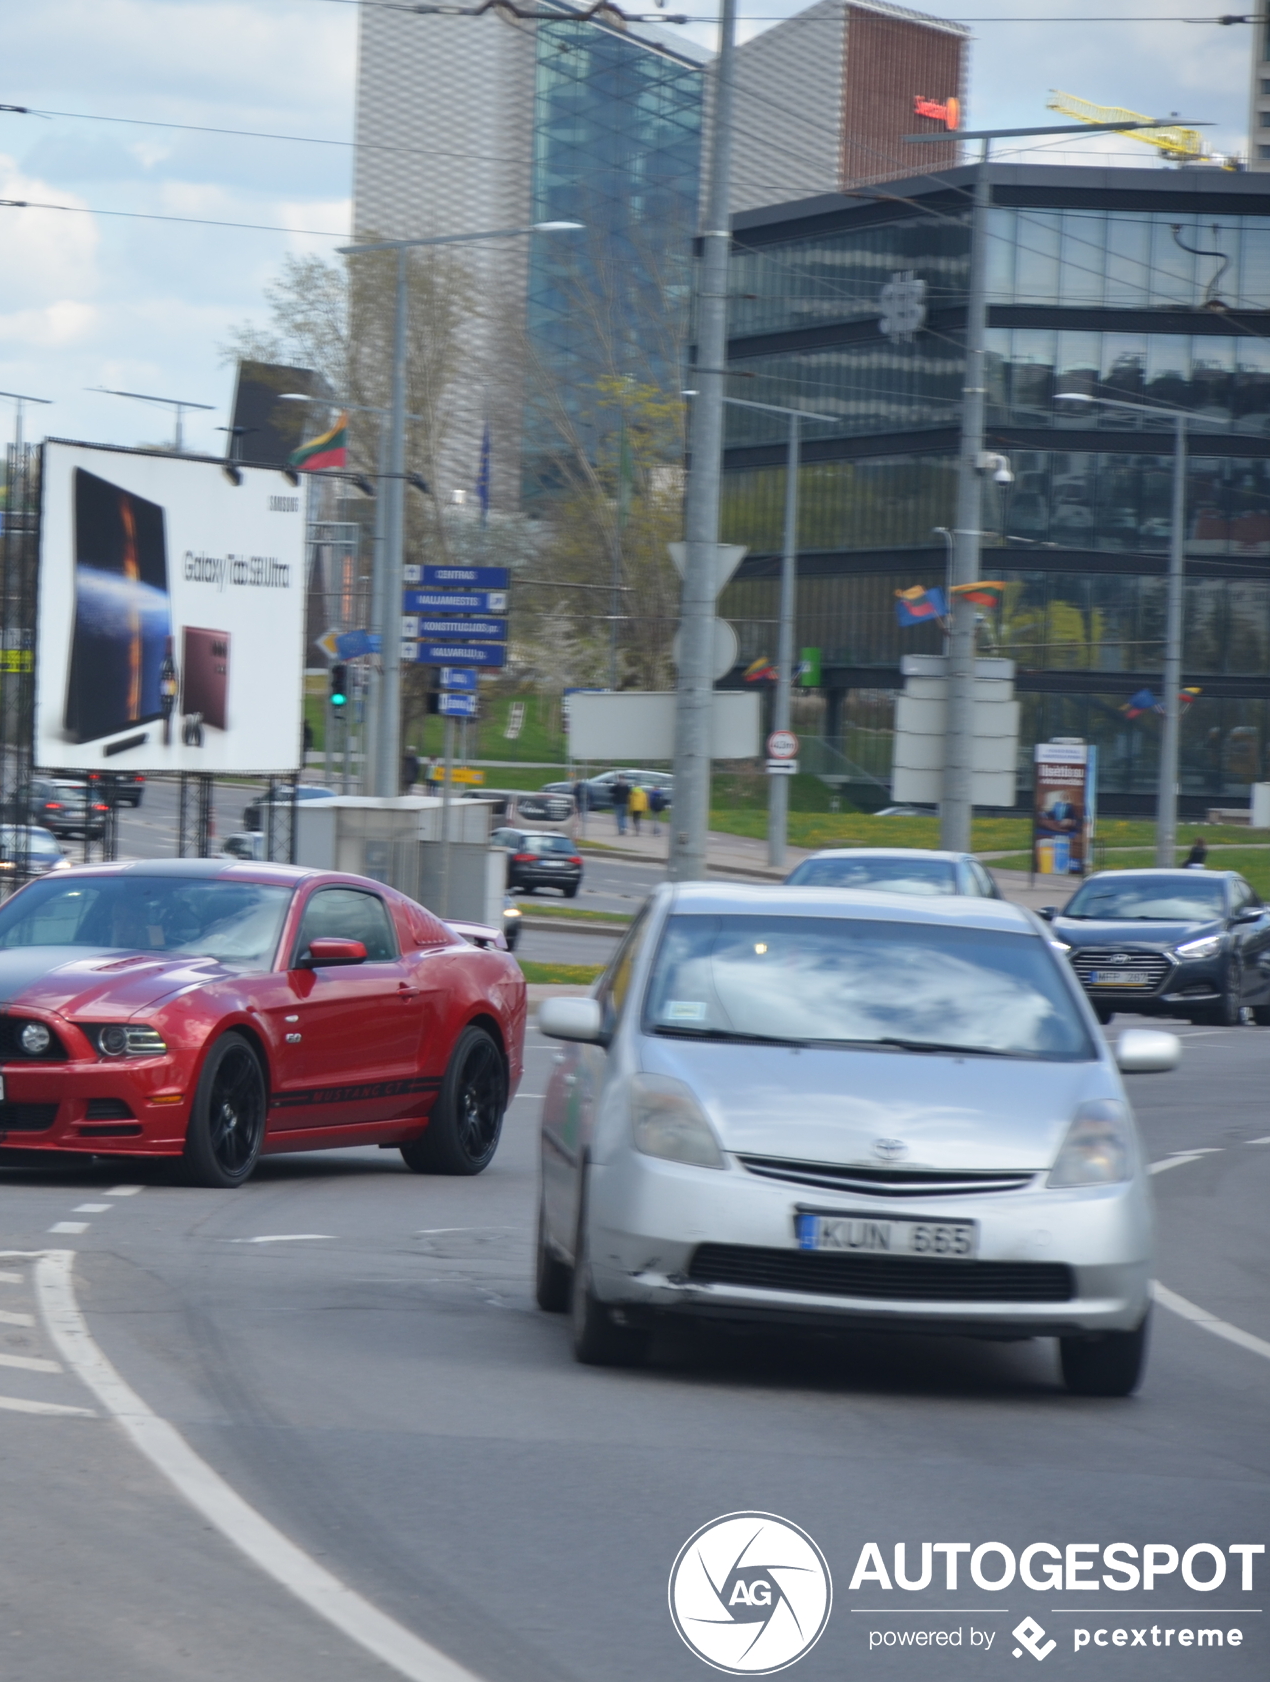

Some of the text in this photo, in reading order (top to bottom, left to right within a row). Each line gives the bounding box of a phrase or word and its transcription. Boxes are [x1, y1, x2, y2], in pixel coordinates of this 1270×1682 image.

[184, 550, 226, 592] Galaxy
[435, 570, 478, 580] CENTRAS
[313, 1081, 404, 1102] MUSTANG GT
[819, 1219, 973, 1255] KUN 665
